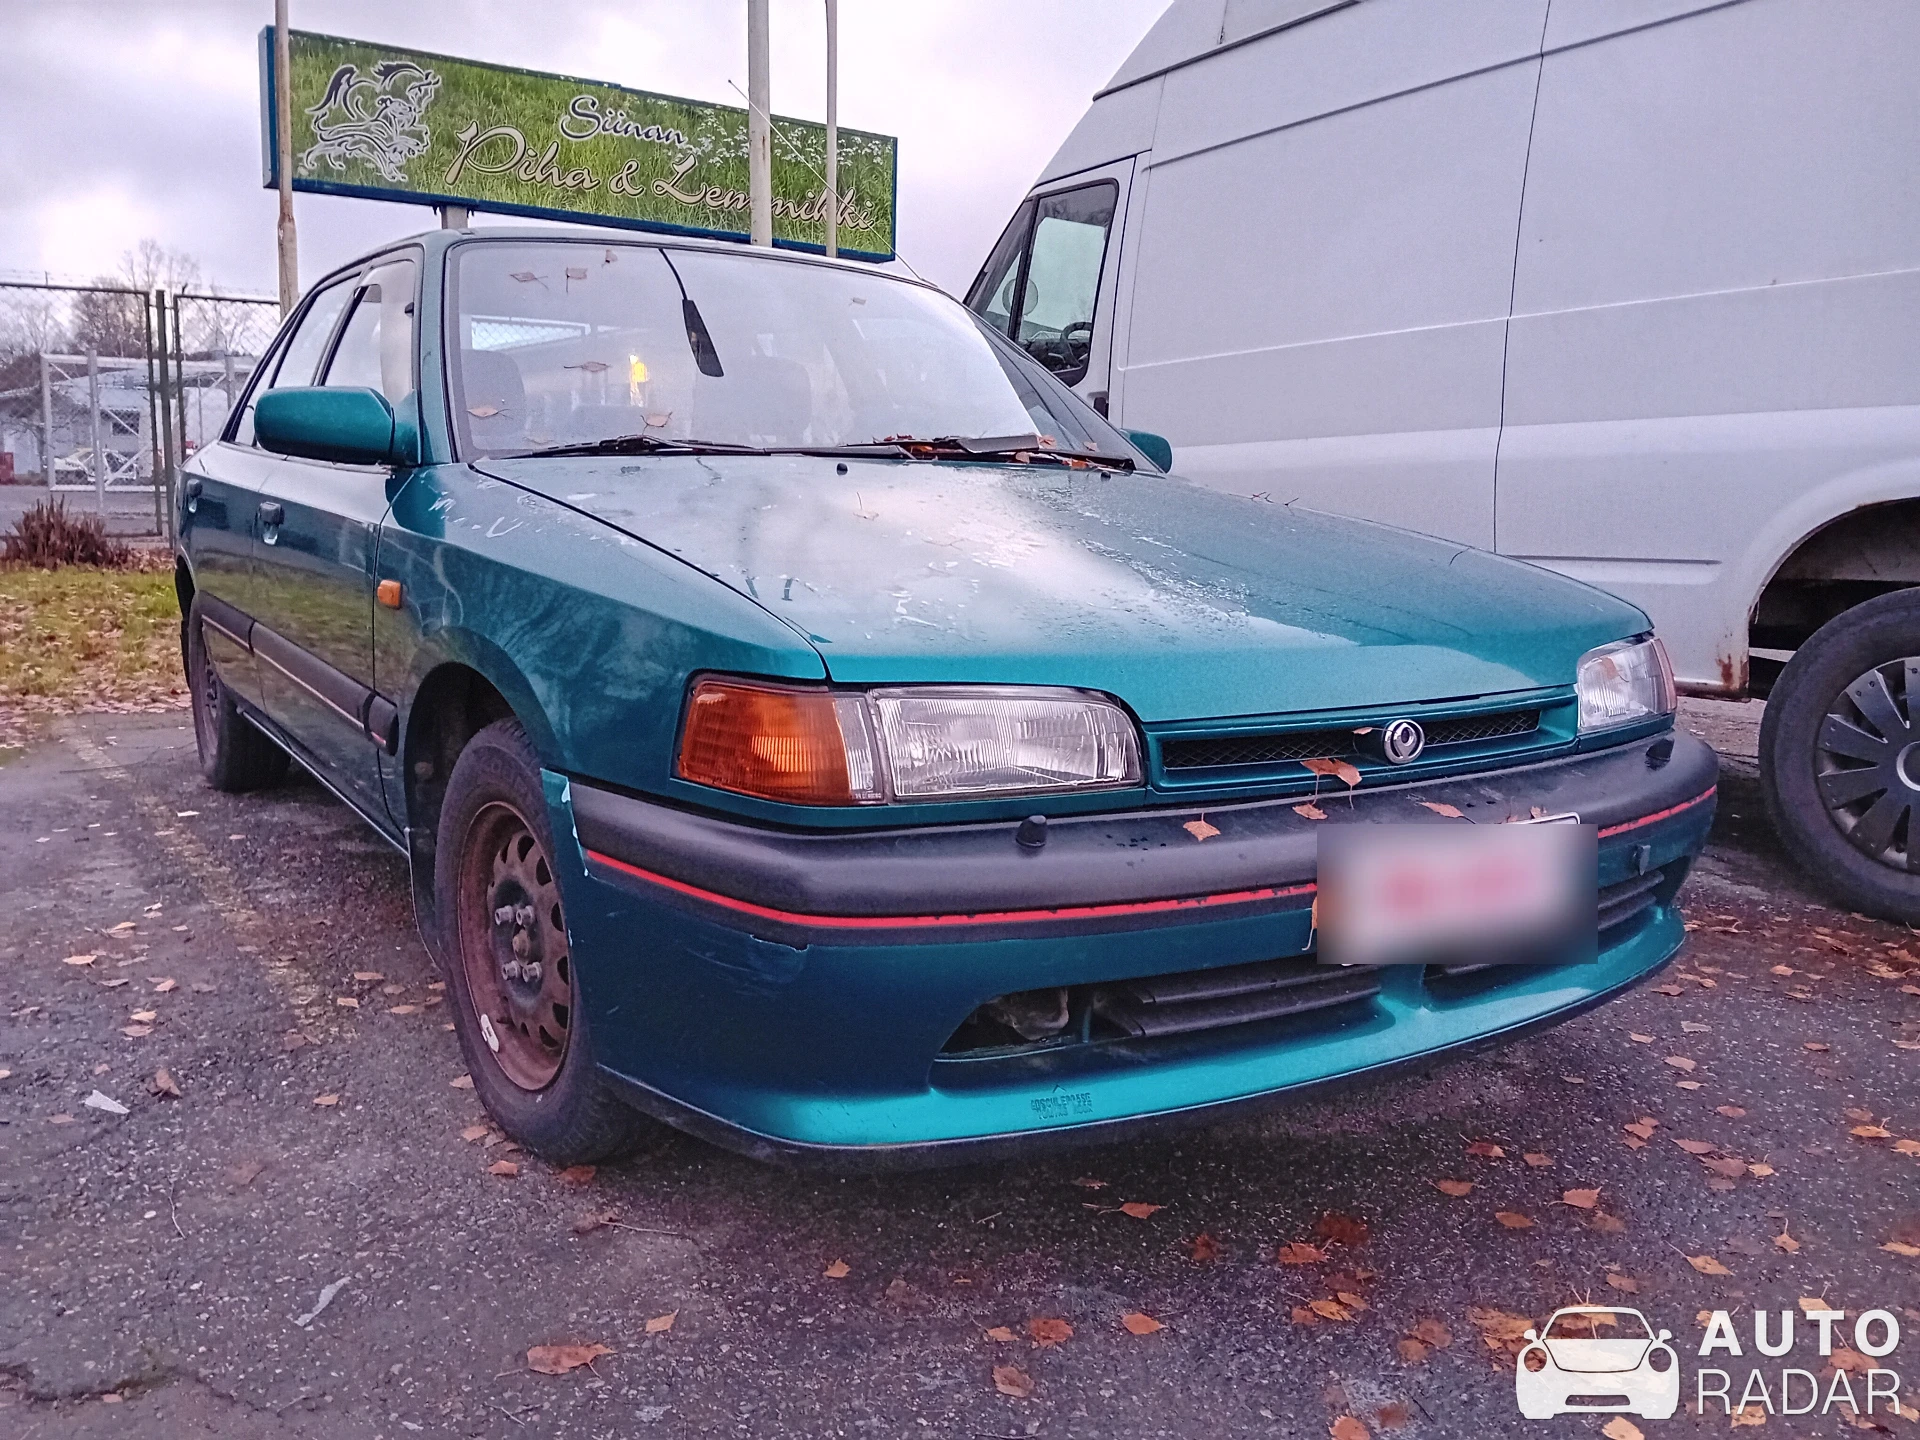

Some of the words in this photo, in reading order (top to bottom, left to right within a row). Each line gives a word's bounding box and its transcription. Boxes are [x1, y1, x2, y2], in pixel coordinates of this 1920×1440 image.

[560, 95, 688, 147] Siinan
[445, 121, 600, 191] Piha
[609, 160, 645, 197] &
